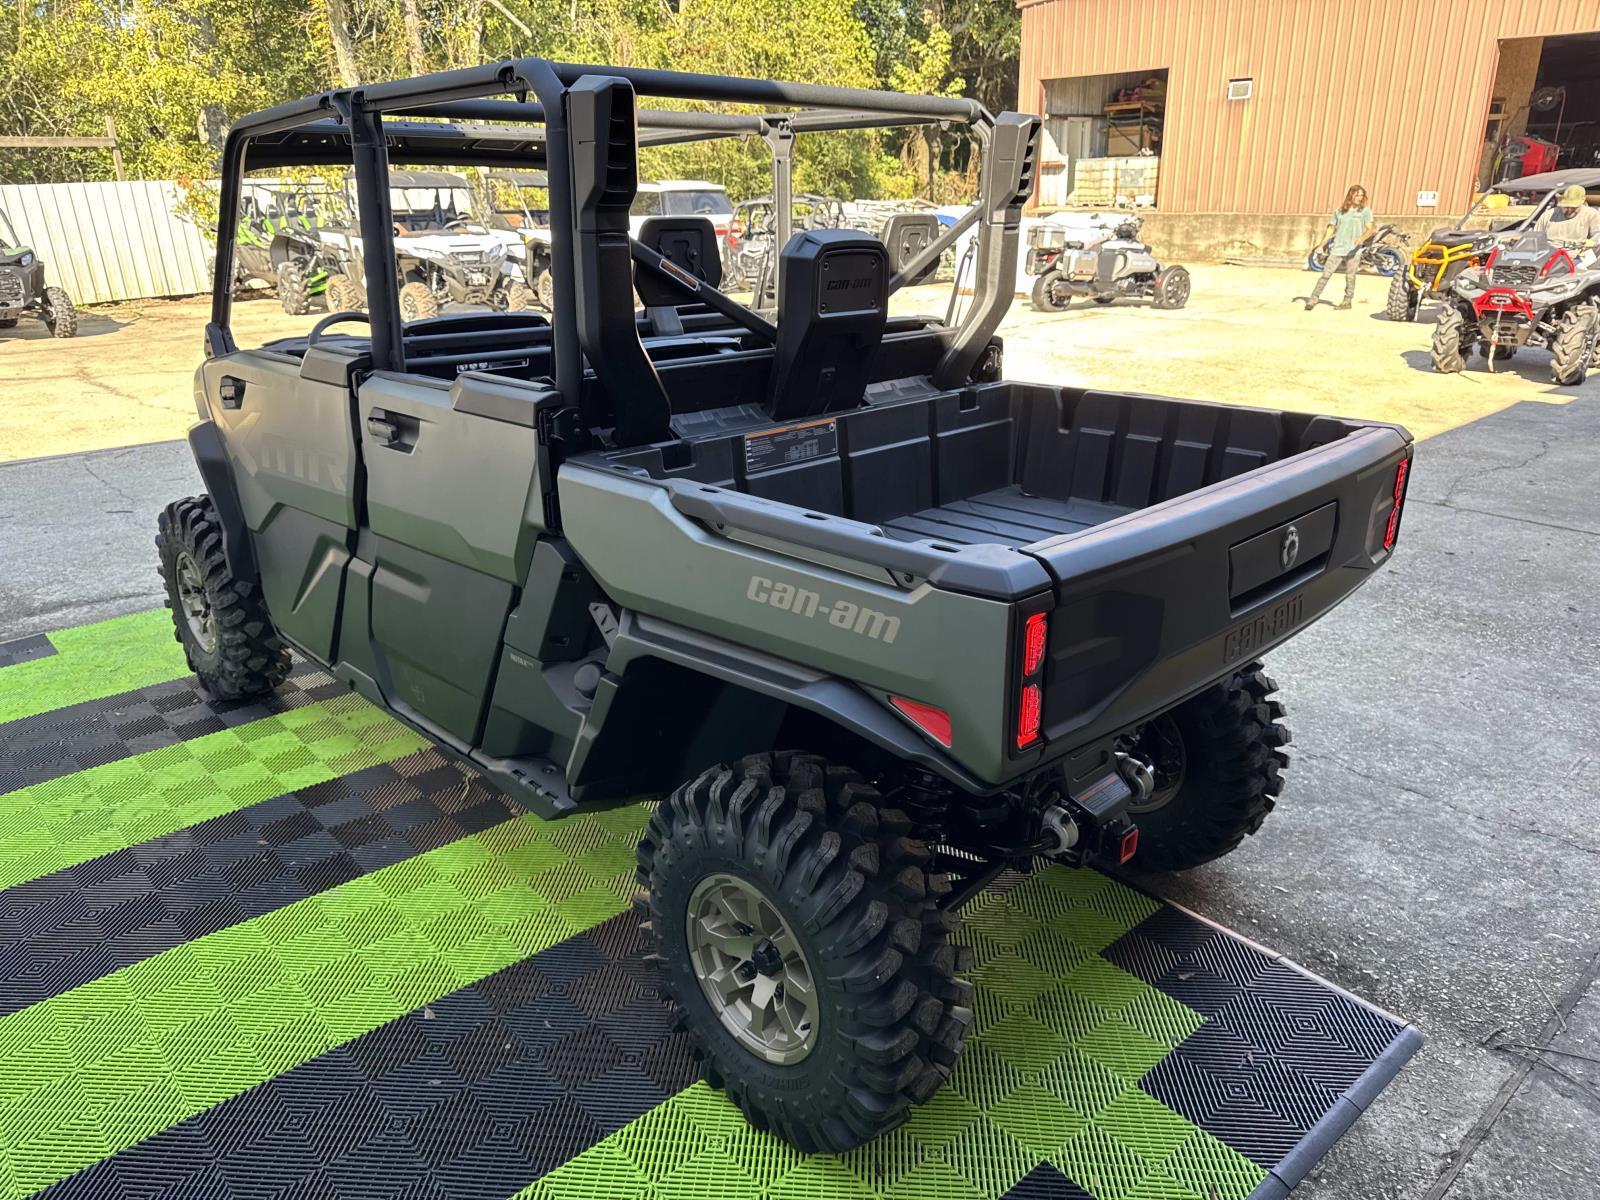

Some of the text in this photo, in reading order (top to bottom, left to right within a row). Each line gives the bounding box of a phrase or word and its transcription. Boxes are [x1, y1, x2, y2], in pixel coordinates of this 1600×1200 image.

[826, 277, 873, 291] can-am
[746, 575, 901, 644] can-am
[1223, 592, 1305, 665] can-am
